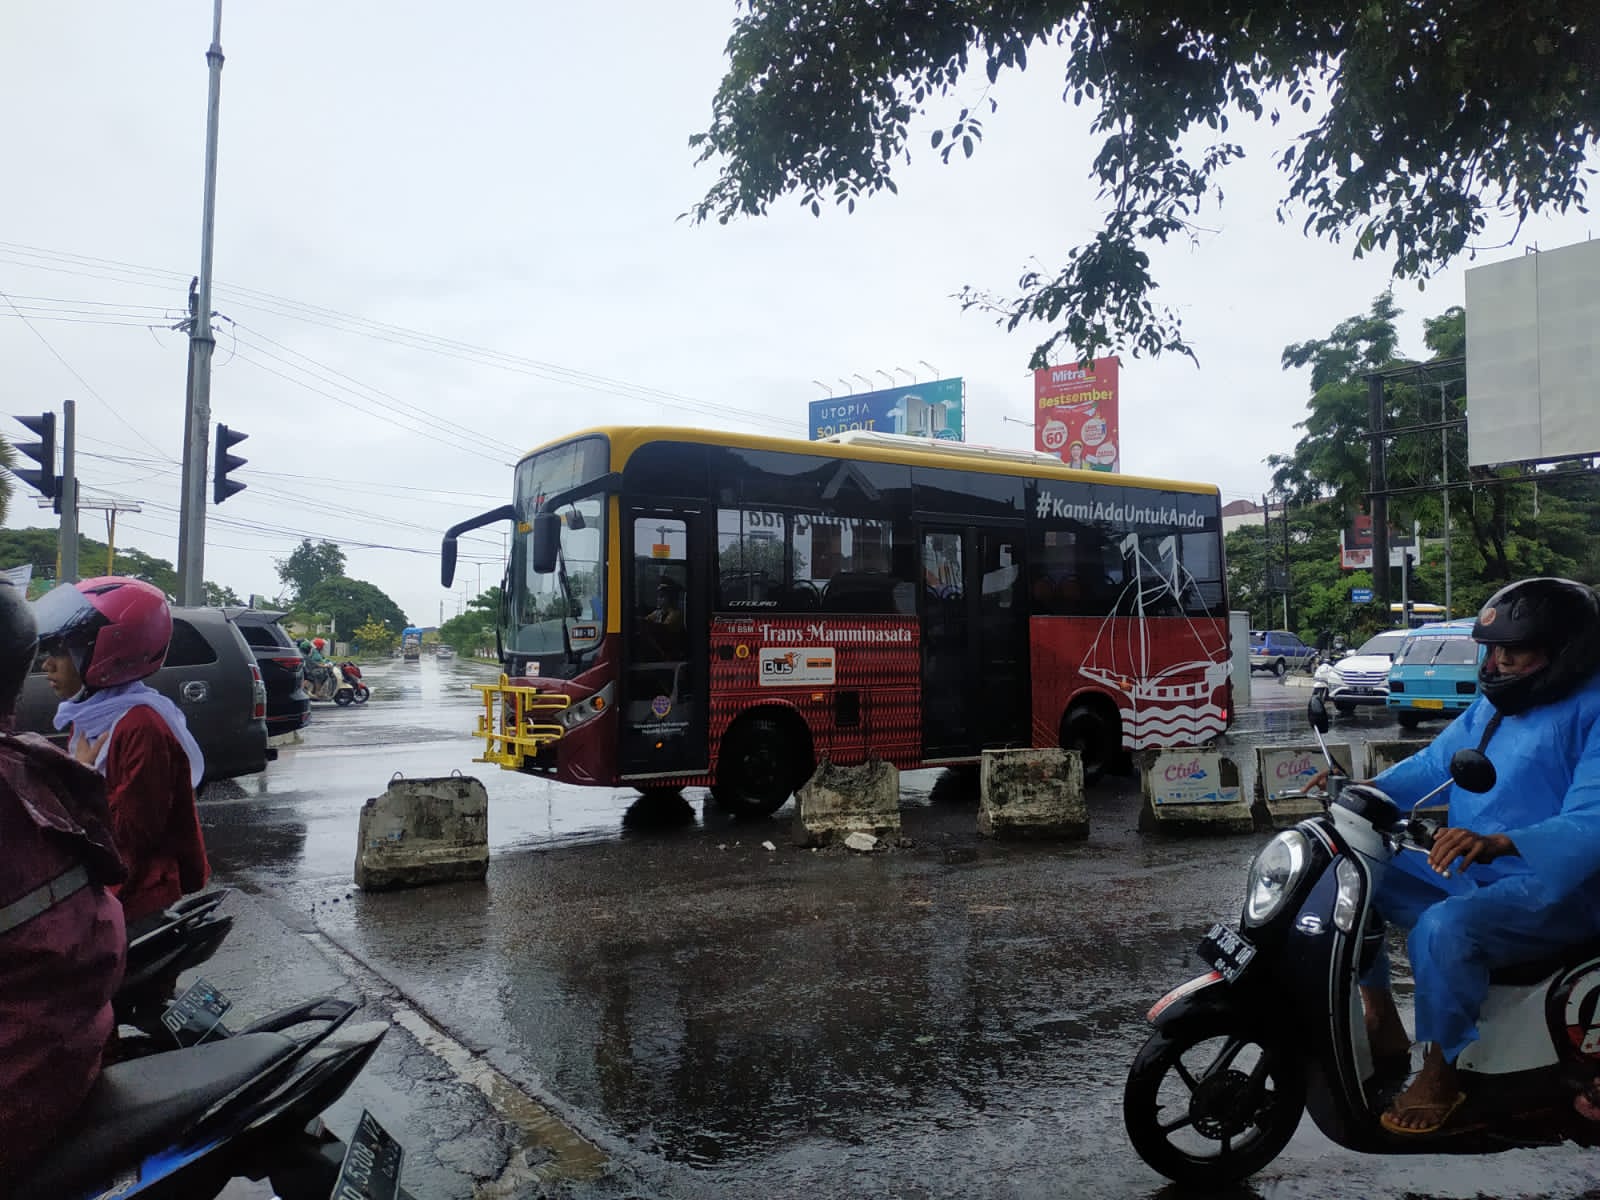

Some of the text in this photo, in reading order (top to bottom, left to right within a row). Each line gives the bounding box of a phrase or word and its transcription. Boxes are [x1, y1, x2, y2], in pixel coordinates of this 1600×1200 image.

[1052, 369, 1086, 383] Mitra
[1038, 388, 1113, 409] Bestsember
[821, 402, 870, 419] UTOPIA
[1035, 491, 1205, 528] #KamiAdaUntukAnda
[758, 620, 912, 643] Trans Mamminasata
